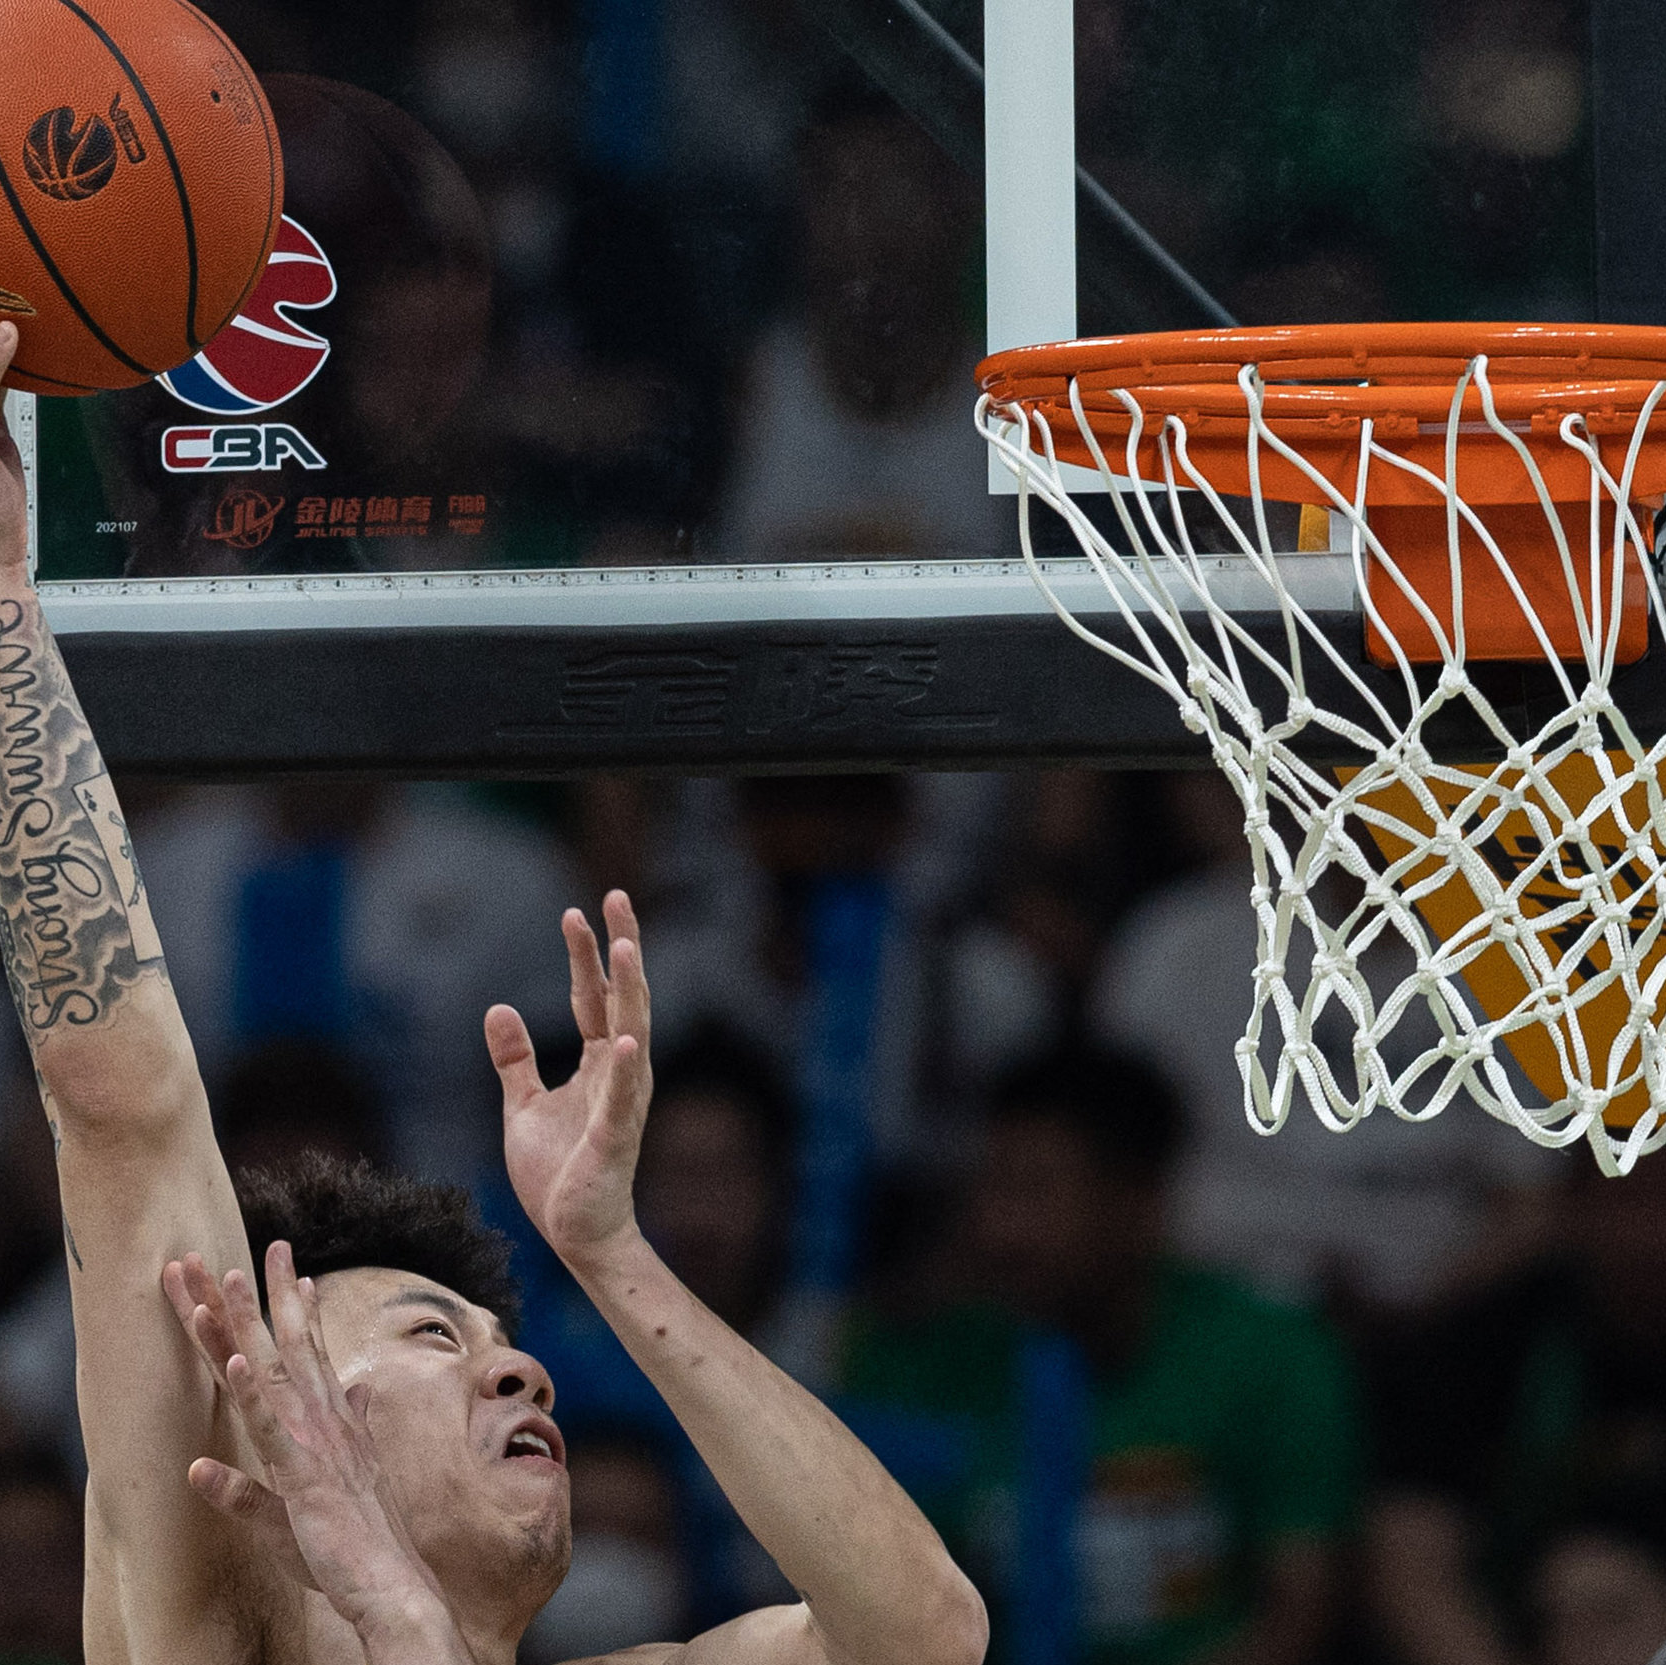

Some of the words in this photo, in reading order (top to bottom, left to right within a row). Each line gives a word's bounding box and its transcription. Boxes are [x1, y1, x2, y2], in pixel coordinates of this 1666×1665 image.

[161, 424, 328, 473] CBA
[95, 520, 138, 533] 202107
[17, 840, 101, 1030] Strong
